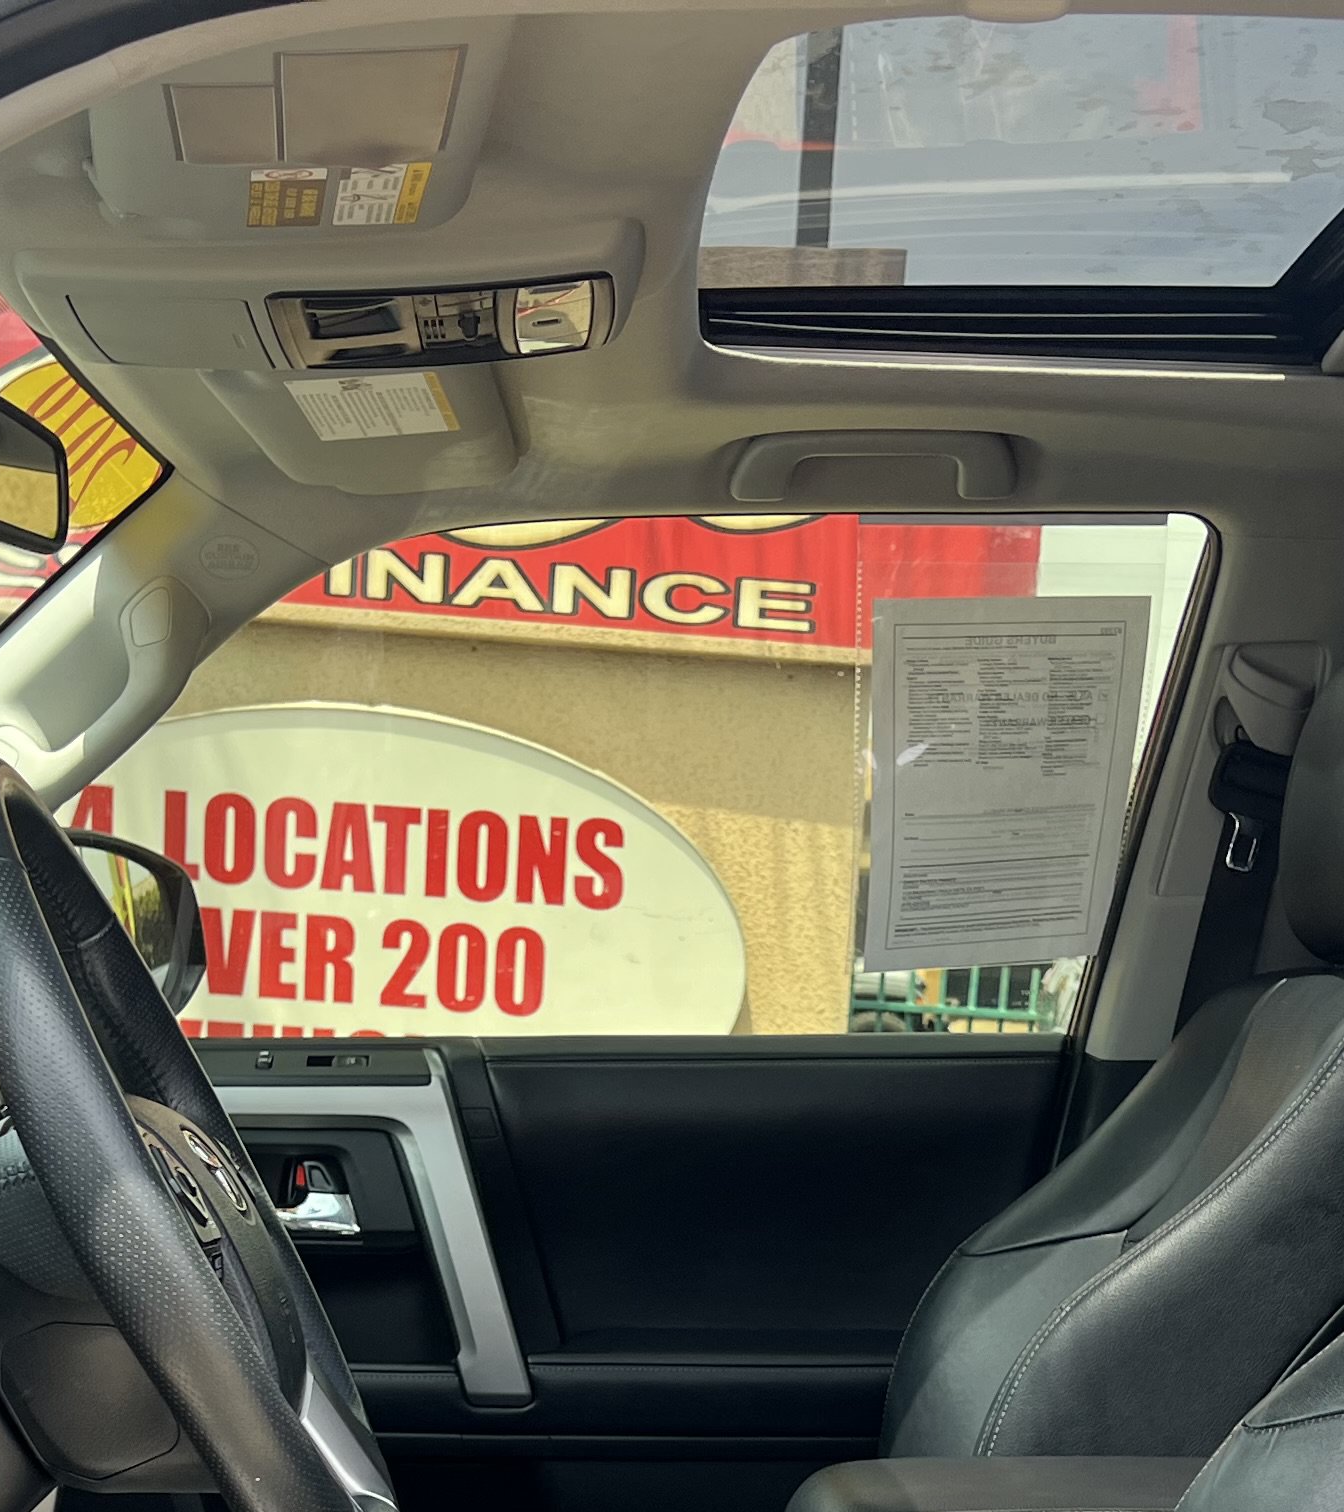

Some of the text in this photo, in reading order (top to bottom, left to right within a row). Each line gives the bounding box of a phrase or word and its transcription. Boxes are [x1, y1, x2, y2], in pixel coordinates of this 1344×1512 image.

[326, 547, 818, 634] INANCE
[163, 789, 626, 911] LOCATIONS
[198, 907, 545, 1018] VER 200
